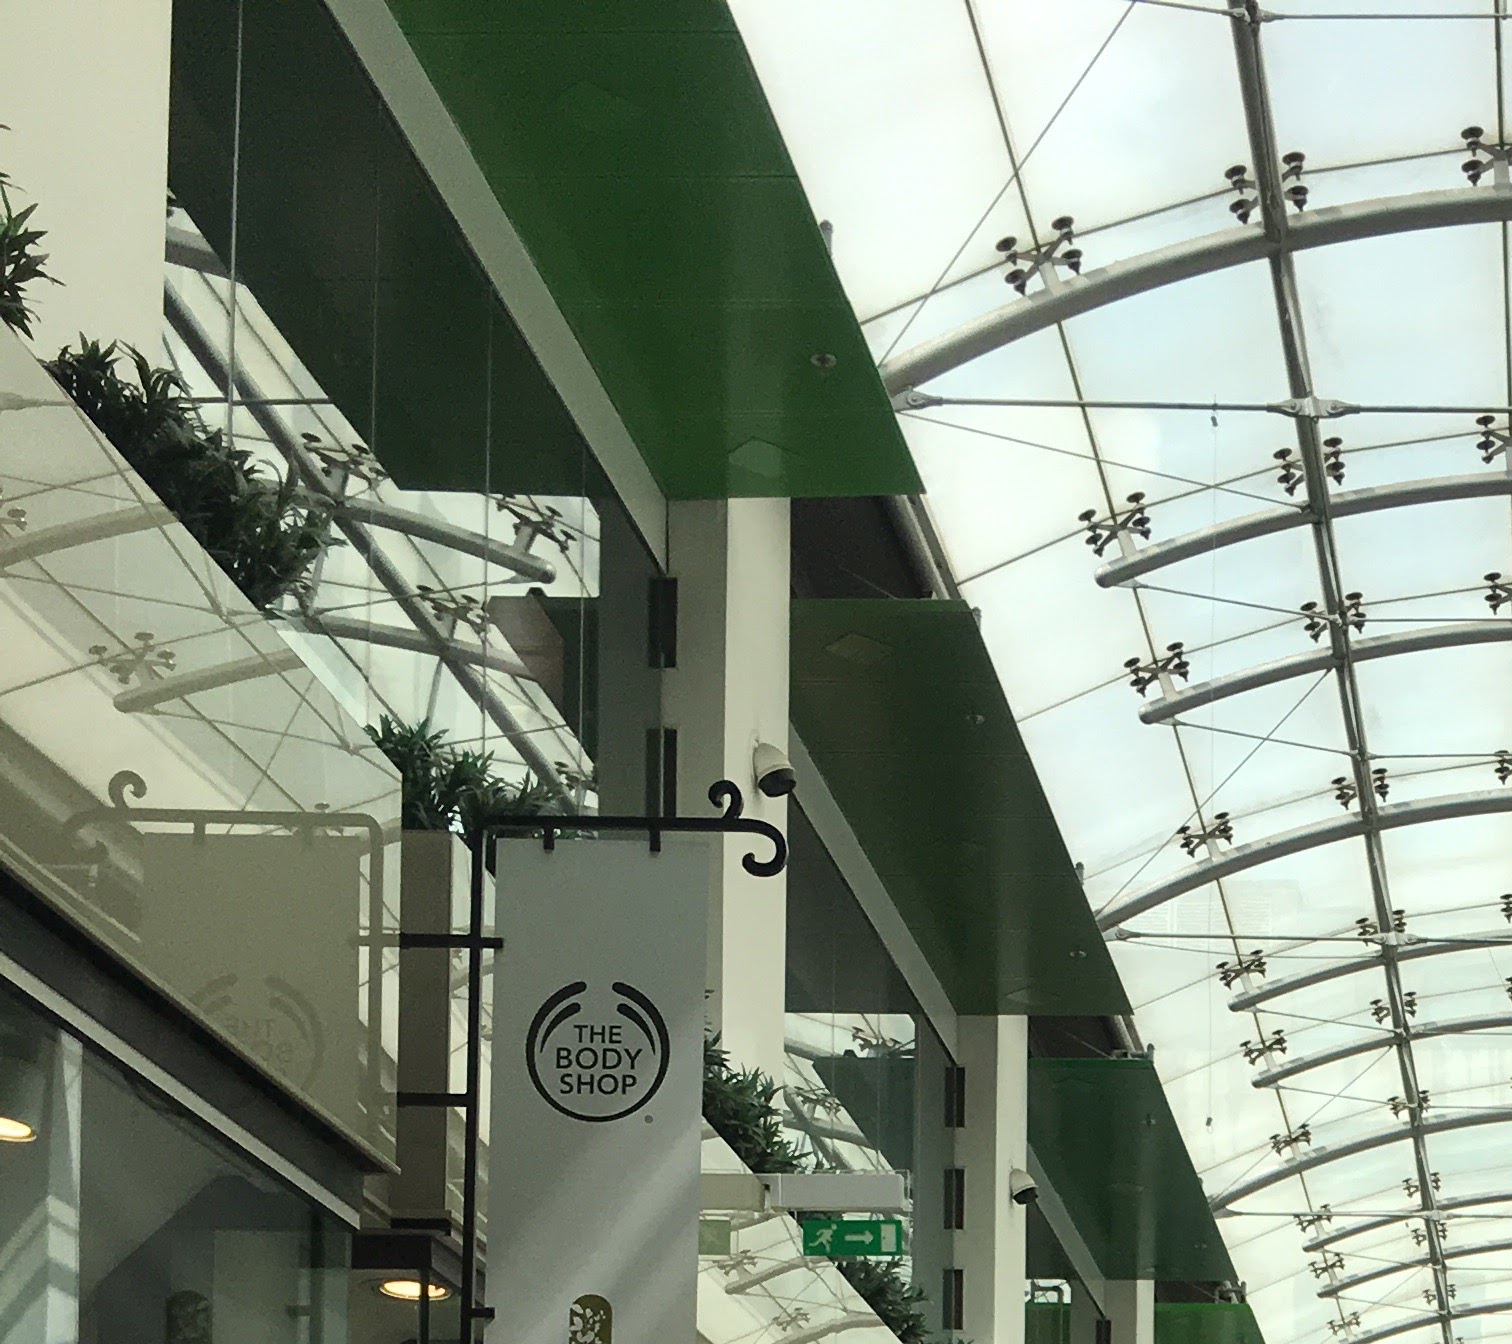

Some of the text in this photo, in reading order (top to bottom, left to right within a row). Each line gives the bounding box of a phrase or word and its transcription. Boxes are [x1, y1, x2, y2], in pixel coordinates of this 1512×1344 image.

[574, 1025, 622, 1043] THE
[556, 1047, 642, 1070] BODY
[560, 1073, 637, 1095] SHOP
